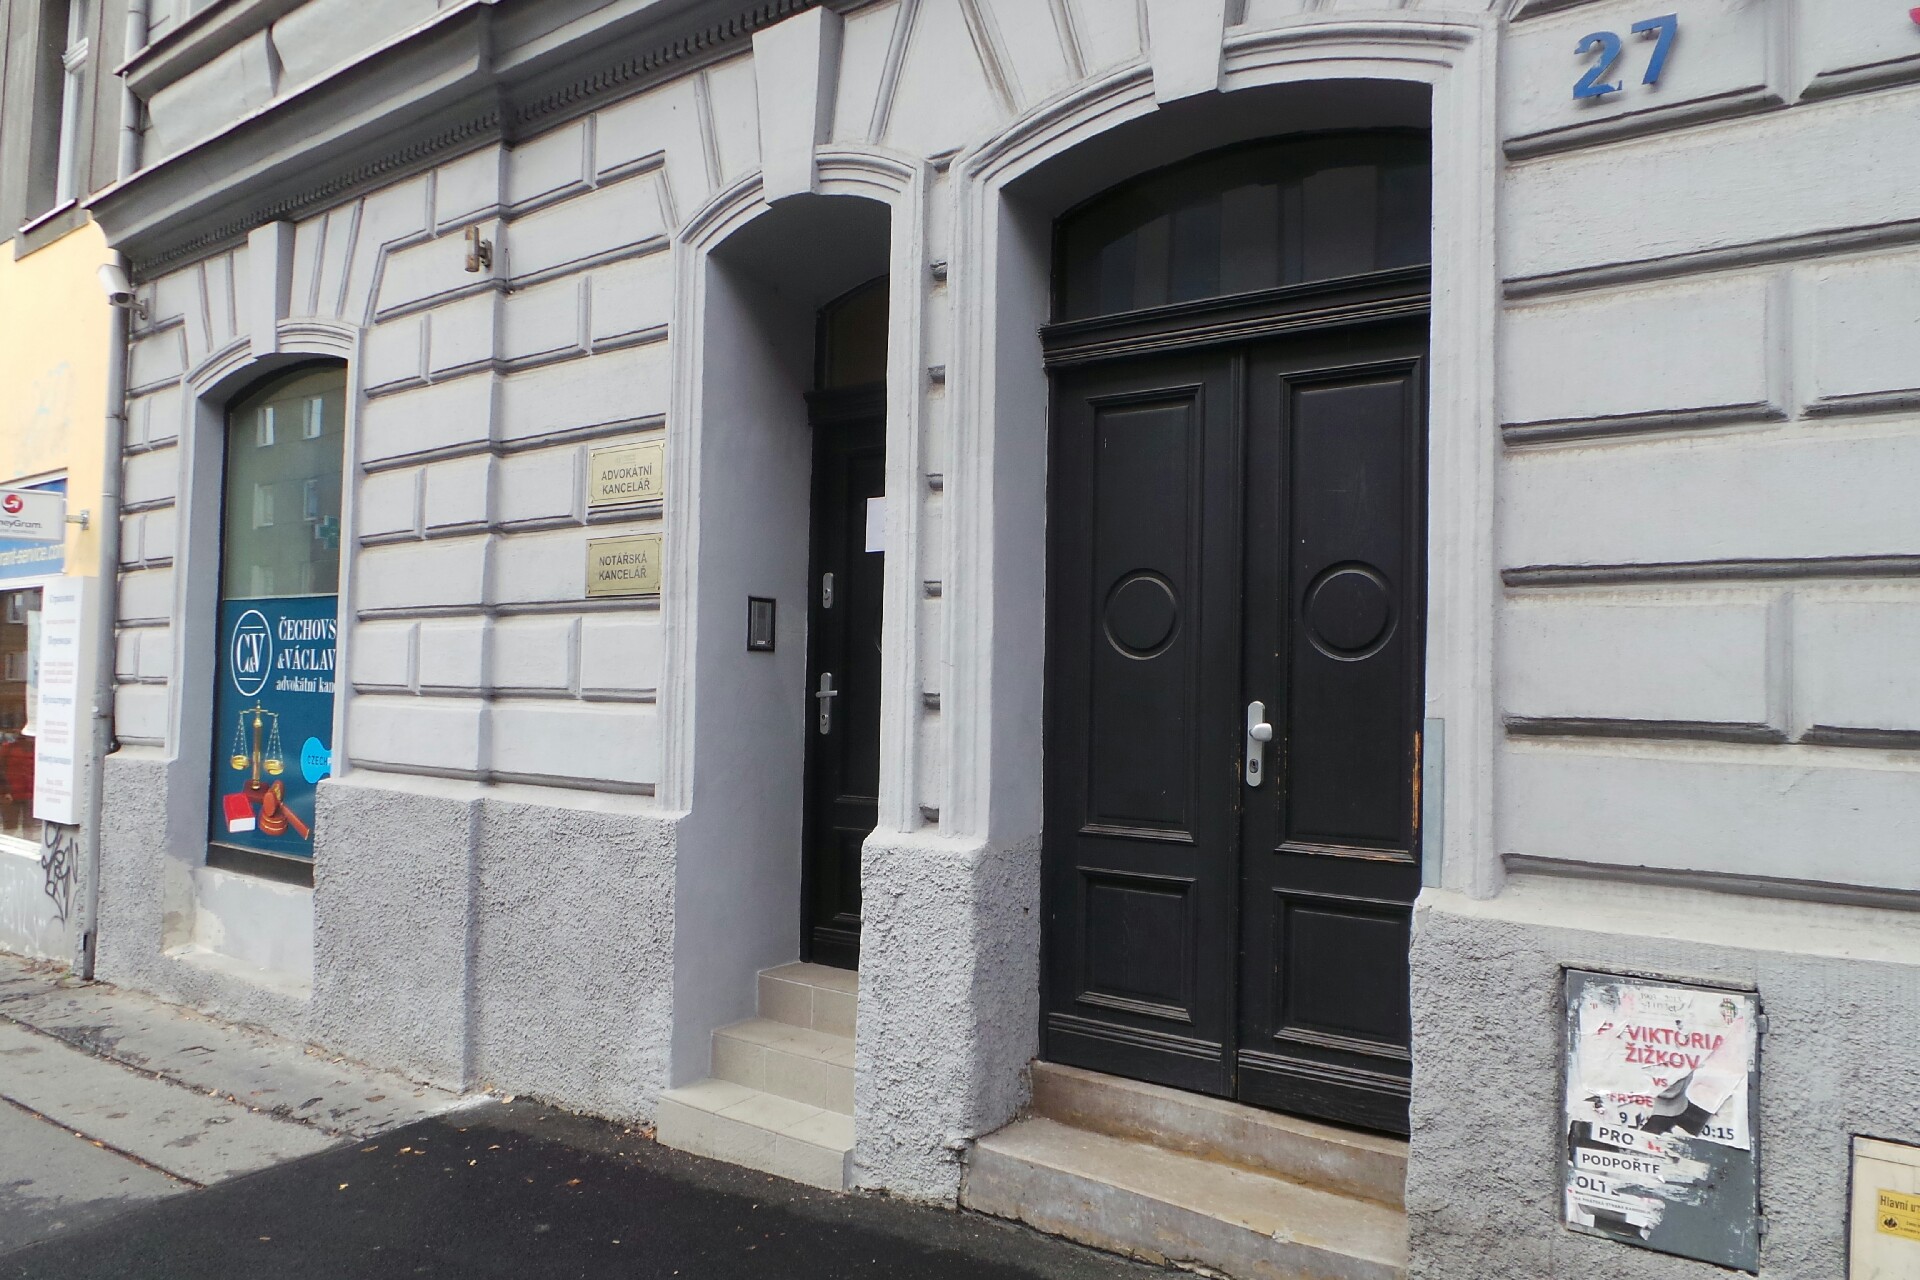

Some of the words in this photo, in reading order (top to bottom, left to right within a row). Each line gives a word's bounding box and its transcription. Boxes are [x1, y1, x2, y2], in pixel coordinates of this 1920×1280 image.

[1573, 12, 1678, 100] 27
[601, 462, 652, 480] ADVOKÁTNÍ
[602, 477, 650, 495] KANCELÁŘ
[599, 550, 648, 566] NOTÁŘSKÁ
[599, 565, 647, 581] KANCELÁŘ
[278, 616, 337, 641] ČECHOVS
[276, 675, 317, 692] advokátní
[307, 755, 328, 766] CZECH
[1627, 1025, 1725, 1050] VIKTORIA
[1625, 1041, 1700, 1070] ŽIŽKOV
[1619, 1111, 1628, 1124] 9
[1599, 1127, 1634, 1145] PRO
[1880, 1195, 1908, 1211] Hlavní
